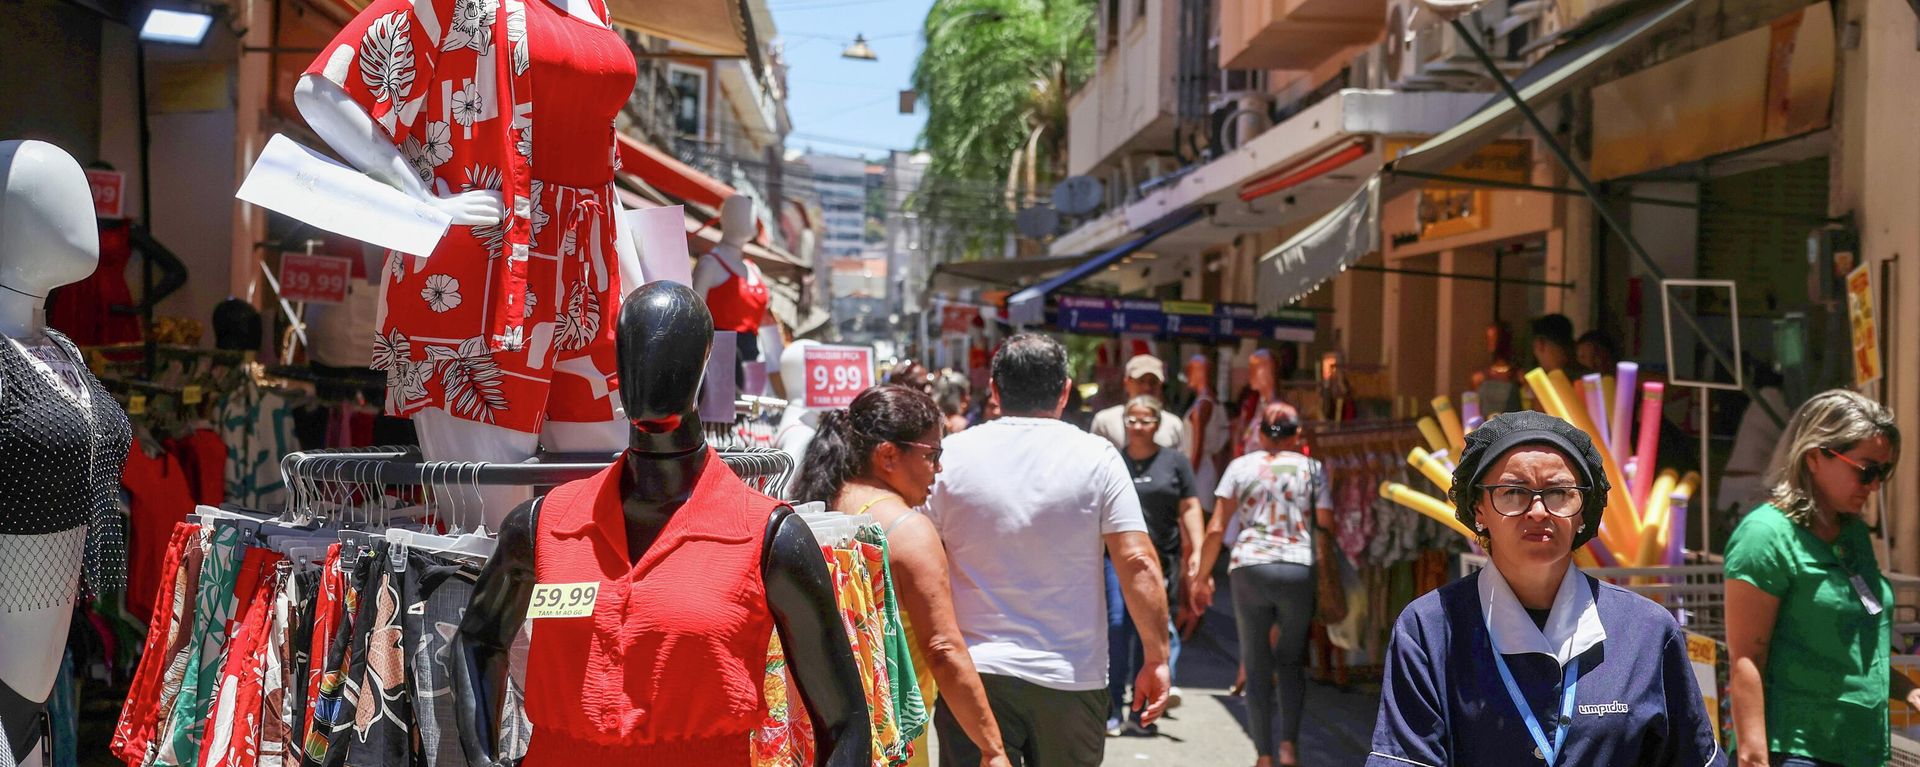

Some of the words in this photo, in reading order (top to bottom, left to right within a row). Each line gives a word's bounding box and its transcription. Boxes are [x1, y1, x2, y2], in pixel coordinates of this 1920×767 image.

[284, 271, 343, 293] 39,99
[813, 364, 862, 394] 9,99
[533, 586, 596, 610] 59,99
